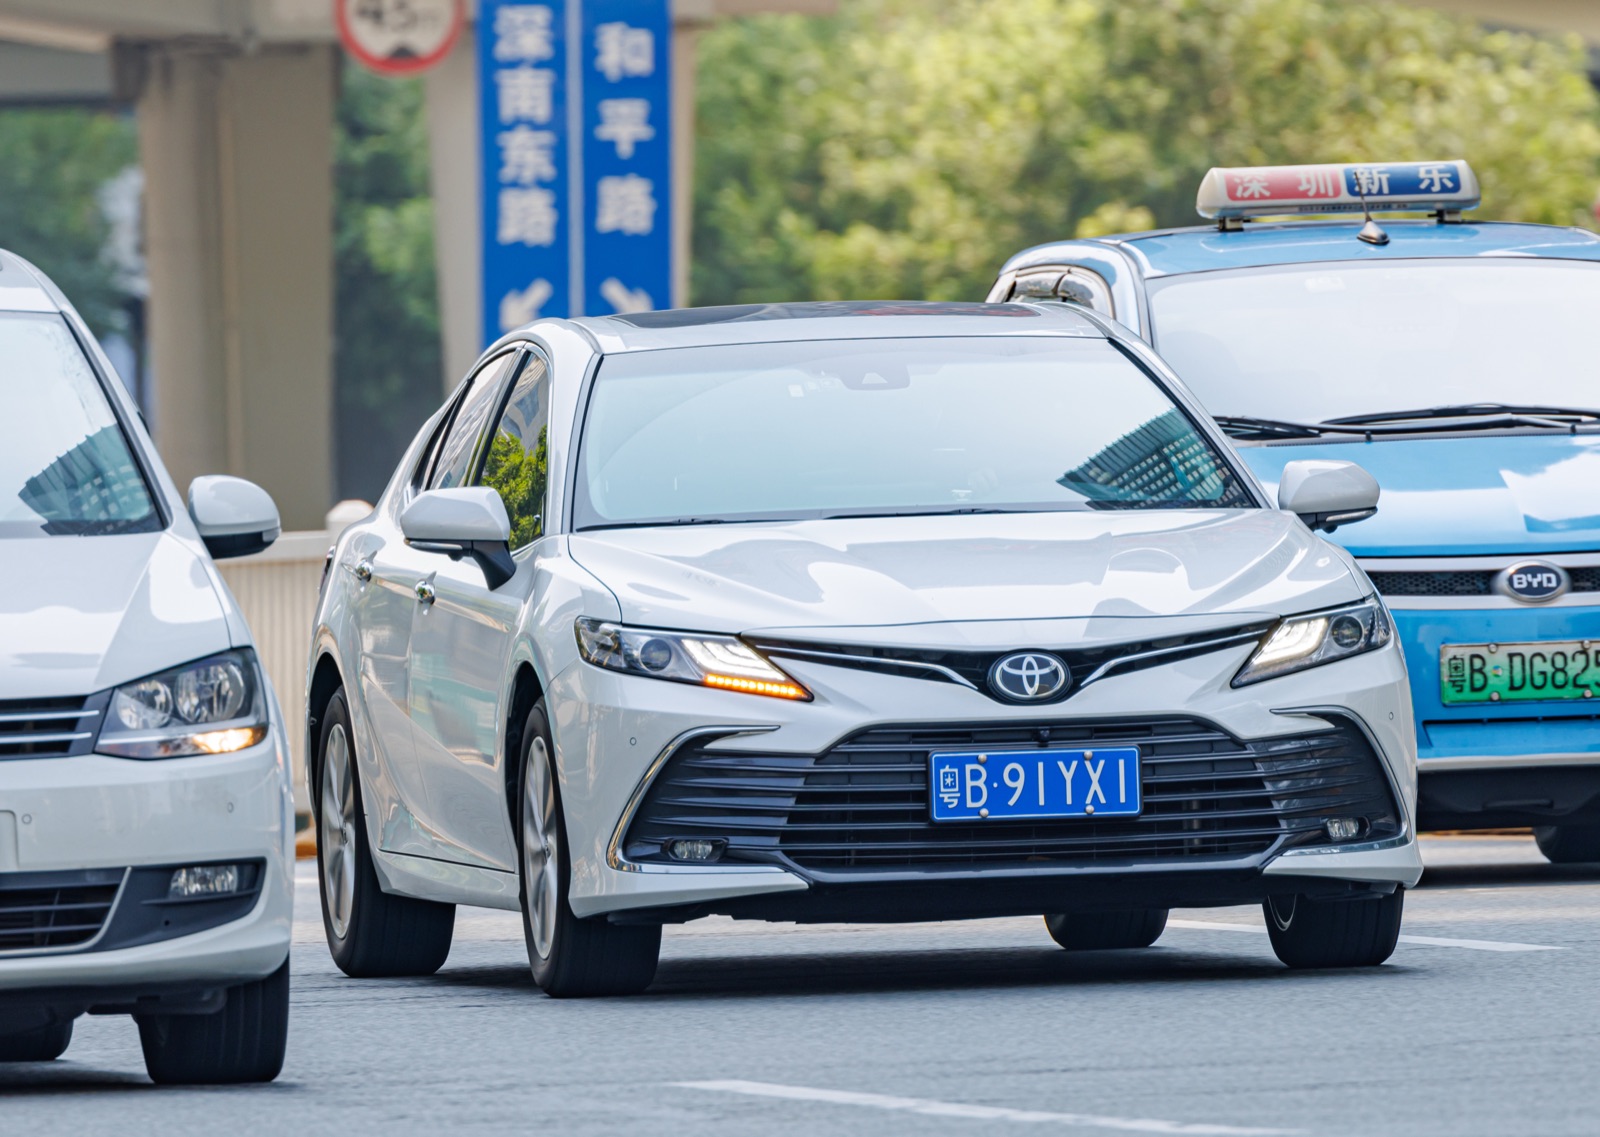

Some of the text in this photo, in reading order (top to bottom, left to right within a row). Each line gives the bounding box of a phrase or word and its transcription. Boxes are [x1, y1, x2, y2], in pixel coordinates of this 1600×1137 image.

[495, 4, 557, 246] 深南东路
[594, 22, 656, 235] 和平路
[1512, 573, 1557, 588] BYD
